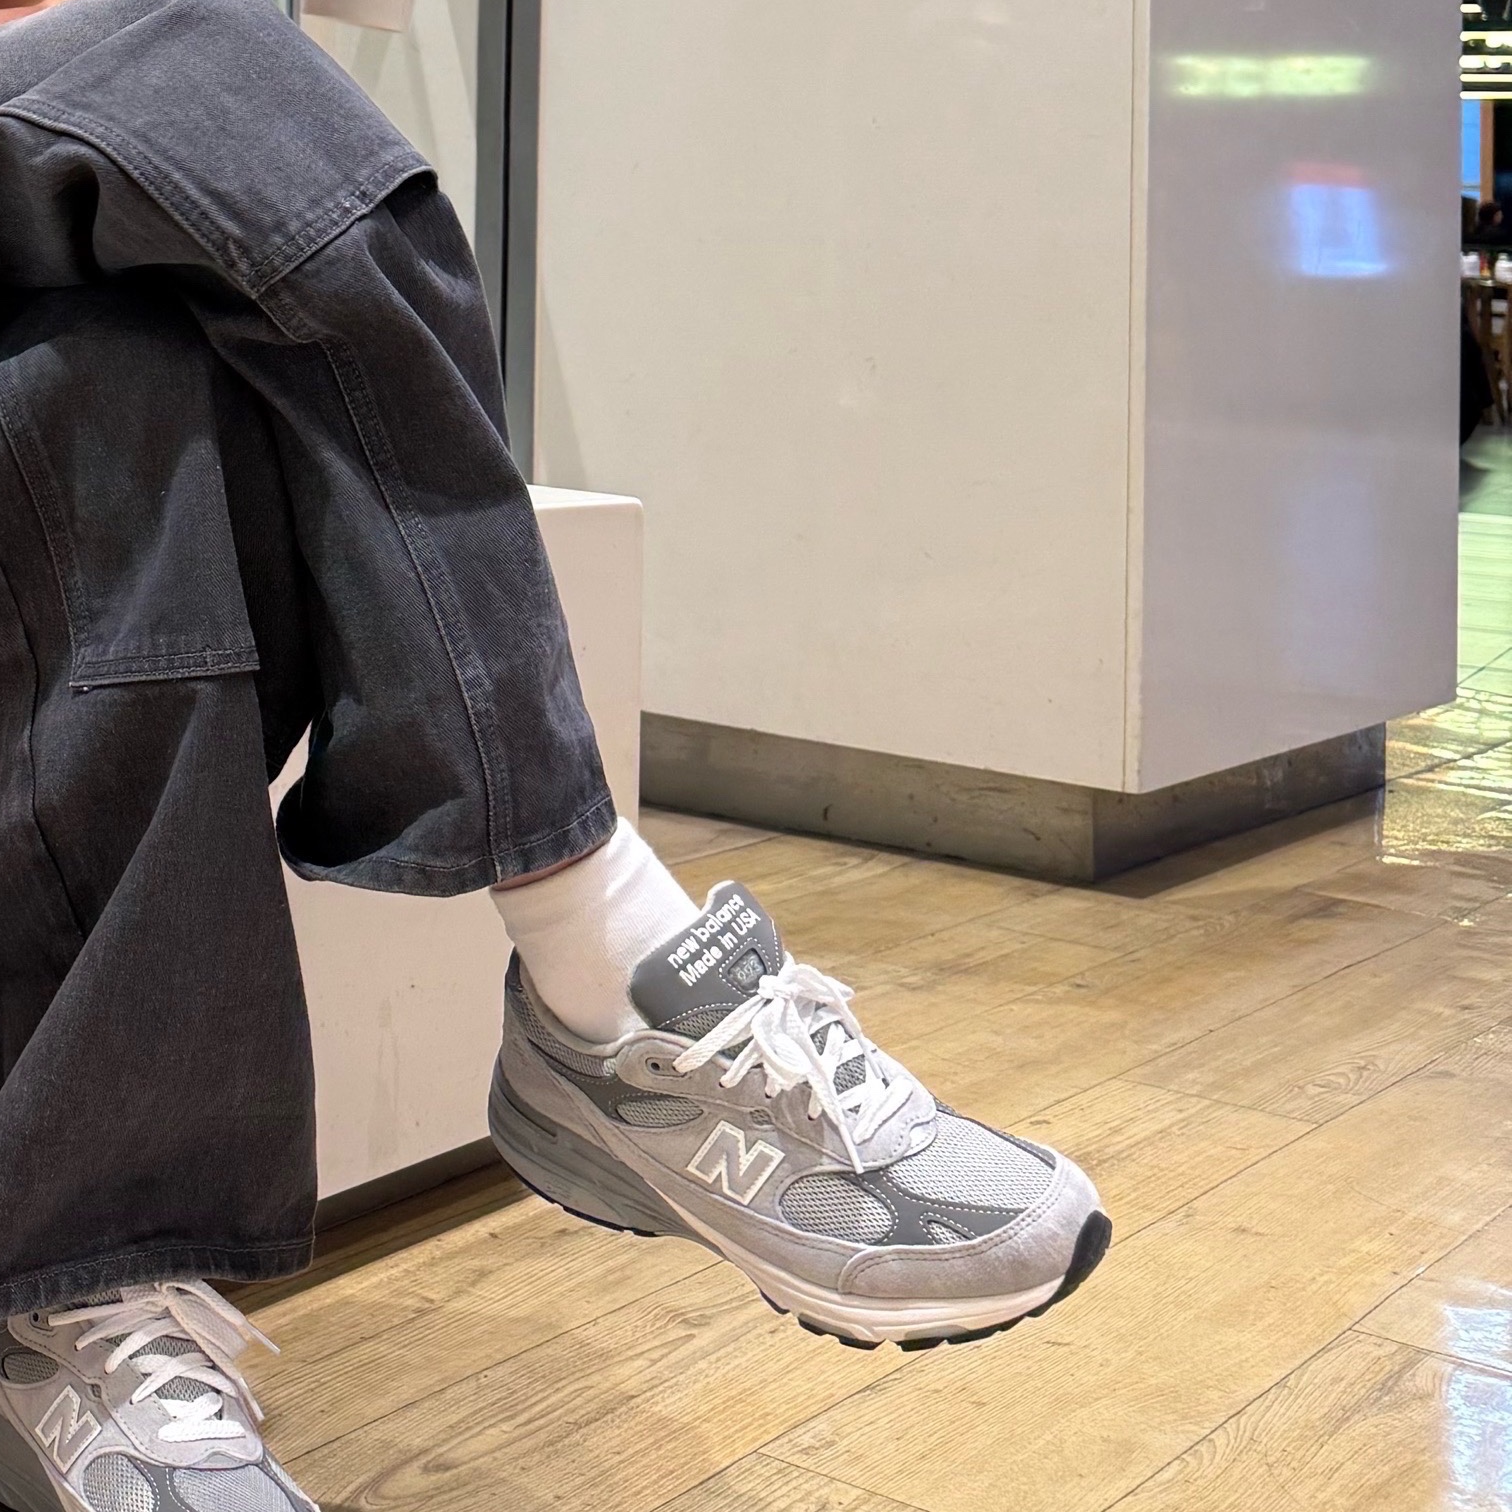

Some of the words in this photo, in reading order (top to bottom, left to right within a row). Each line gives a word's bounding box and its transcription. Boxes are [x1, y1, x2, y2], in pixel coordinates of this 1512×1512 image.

[667, 935, 700, 969] new
[690, 893, 745, 942] balance
[678, 945, 723, 987] Made
[717, 931, 739, 951] in
[731, 907, 762, 936] USA
[686, 1120, 786, 1205] N
[34, 1384, 102, 1474] N
